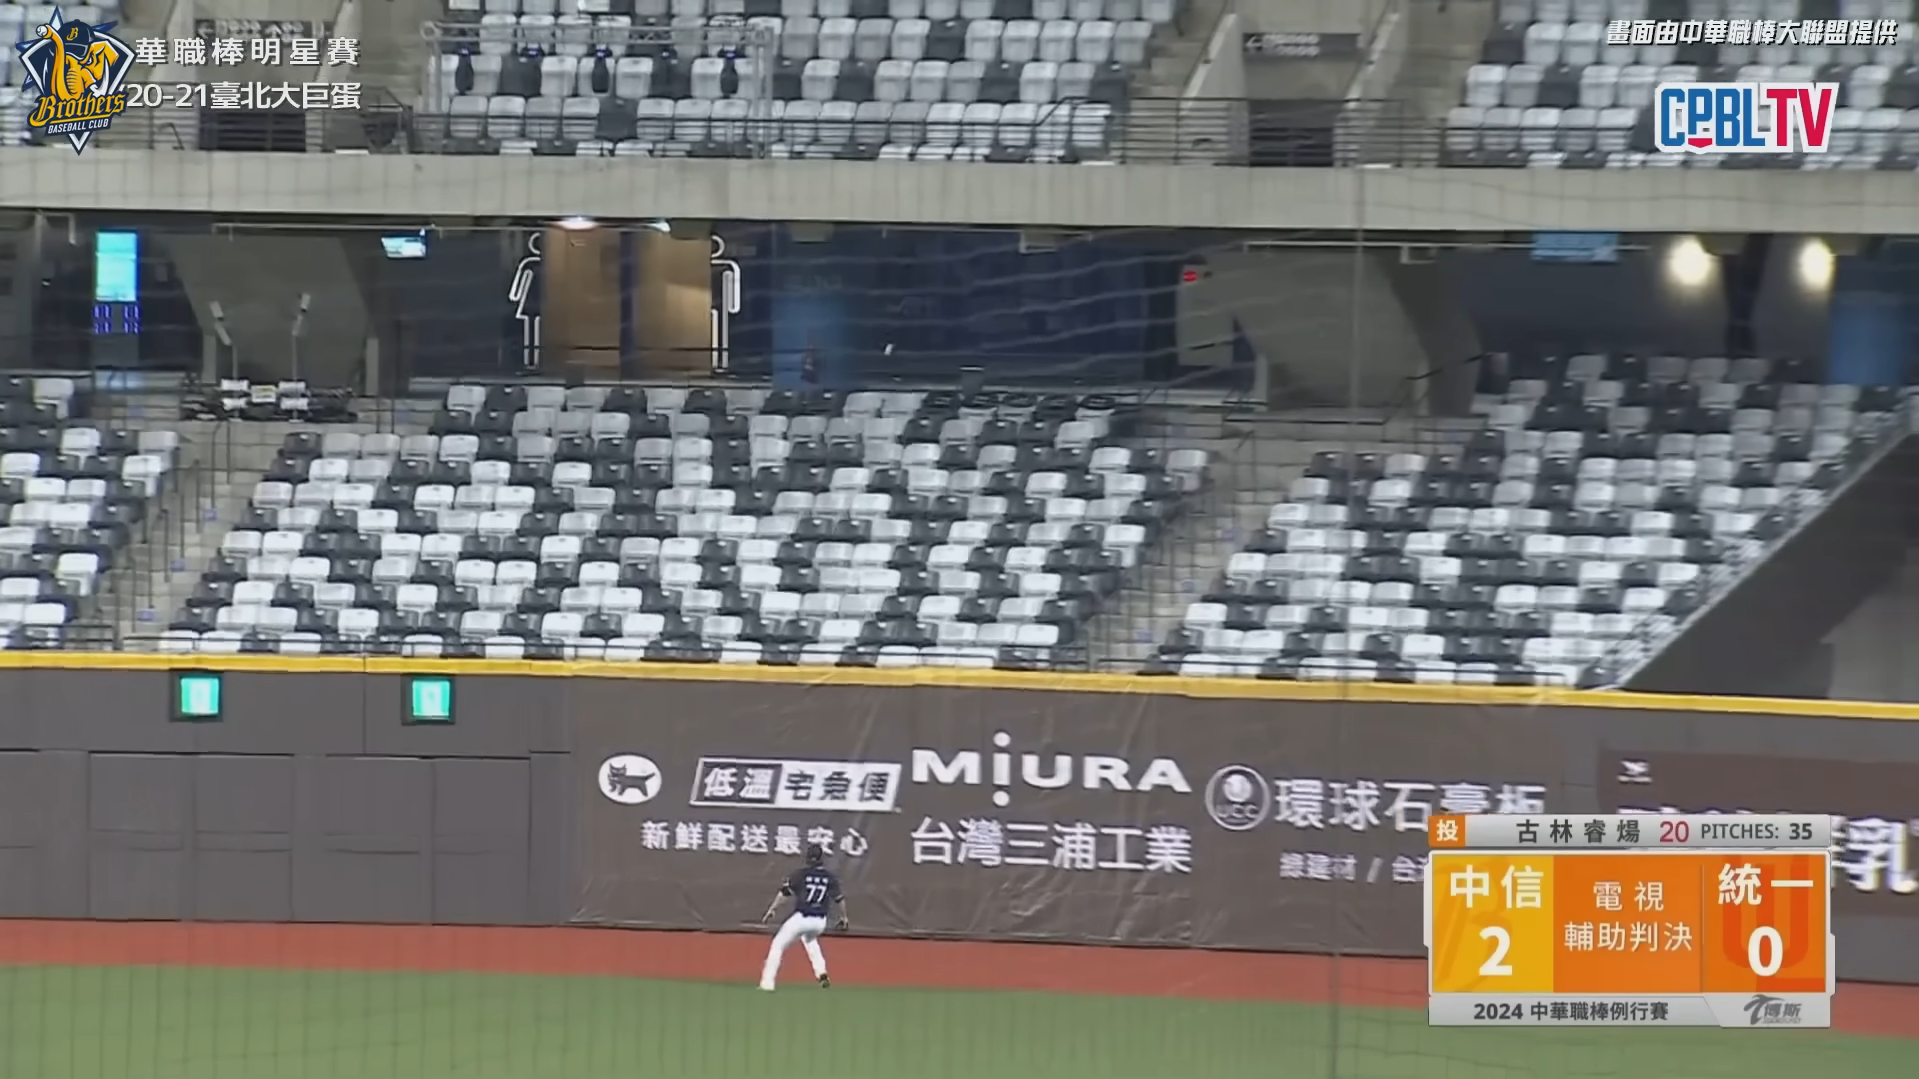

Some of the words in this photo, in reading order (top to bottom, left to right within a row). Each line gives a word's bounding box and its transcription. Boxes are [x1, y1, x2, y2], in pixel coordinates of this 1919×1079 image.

[703, 766, 891, 804] 低溫宅急便
[640, 821, 868, 857] 新鮮配送最安心
[911, 816, 1192, 873] 台灣三浦工業
[806, 884, 827, 903] 77
